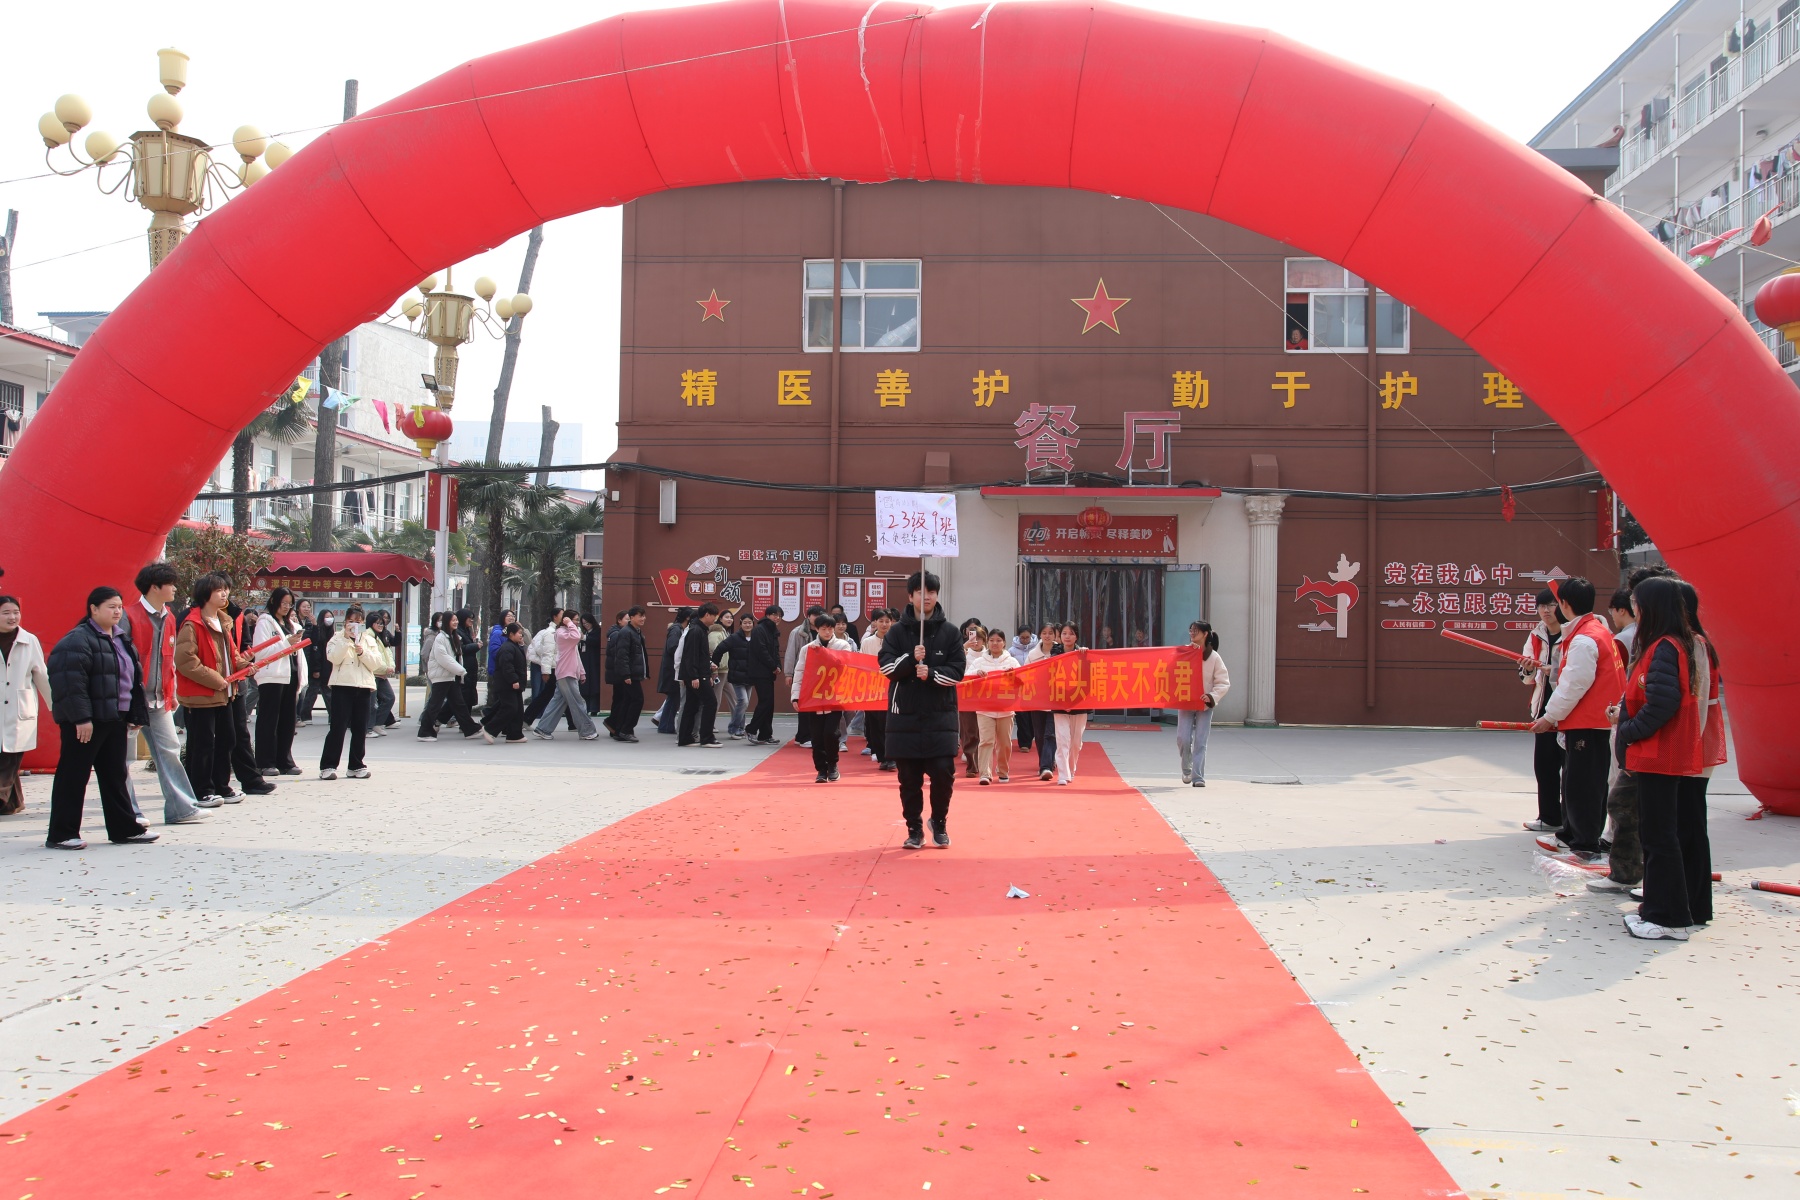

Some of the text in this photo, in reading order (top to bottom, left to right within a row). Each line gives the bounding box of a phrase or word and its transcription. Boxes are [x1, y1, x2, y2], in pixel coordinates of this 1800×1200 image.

[680, 369, 1525, 410] 精医善护 勤于护理
[1014, 403, 1181, 472] 餐厅
[1106, 528, 1153, 540] 尽释美妙
[738, 549, 819, 561] 强化五个引领
[1384, 562, 1513, 586] 党在我心中
[271, 579, 374, 590] 漯河卫生中等专业学校
[690, 582, 715, 593] 党建
[1412, 591, 1537, 615] 永远跟党走
[1392, 620, 1426, 629] 人民有信仰
[1453, 621, 1487, 630] 国家有力量
[1515, 621, 1539, 630] 民族有
[812, 665, 887, 704] 23级9班
[1048, 658, 1193, 702] 抬头晴天不负君
